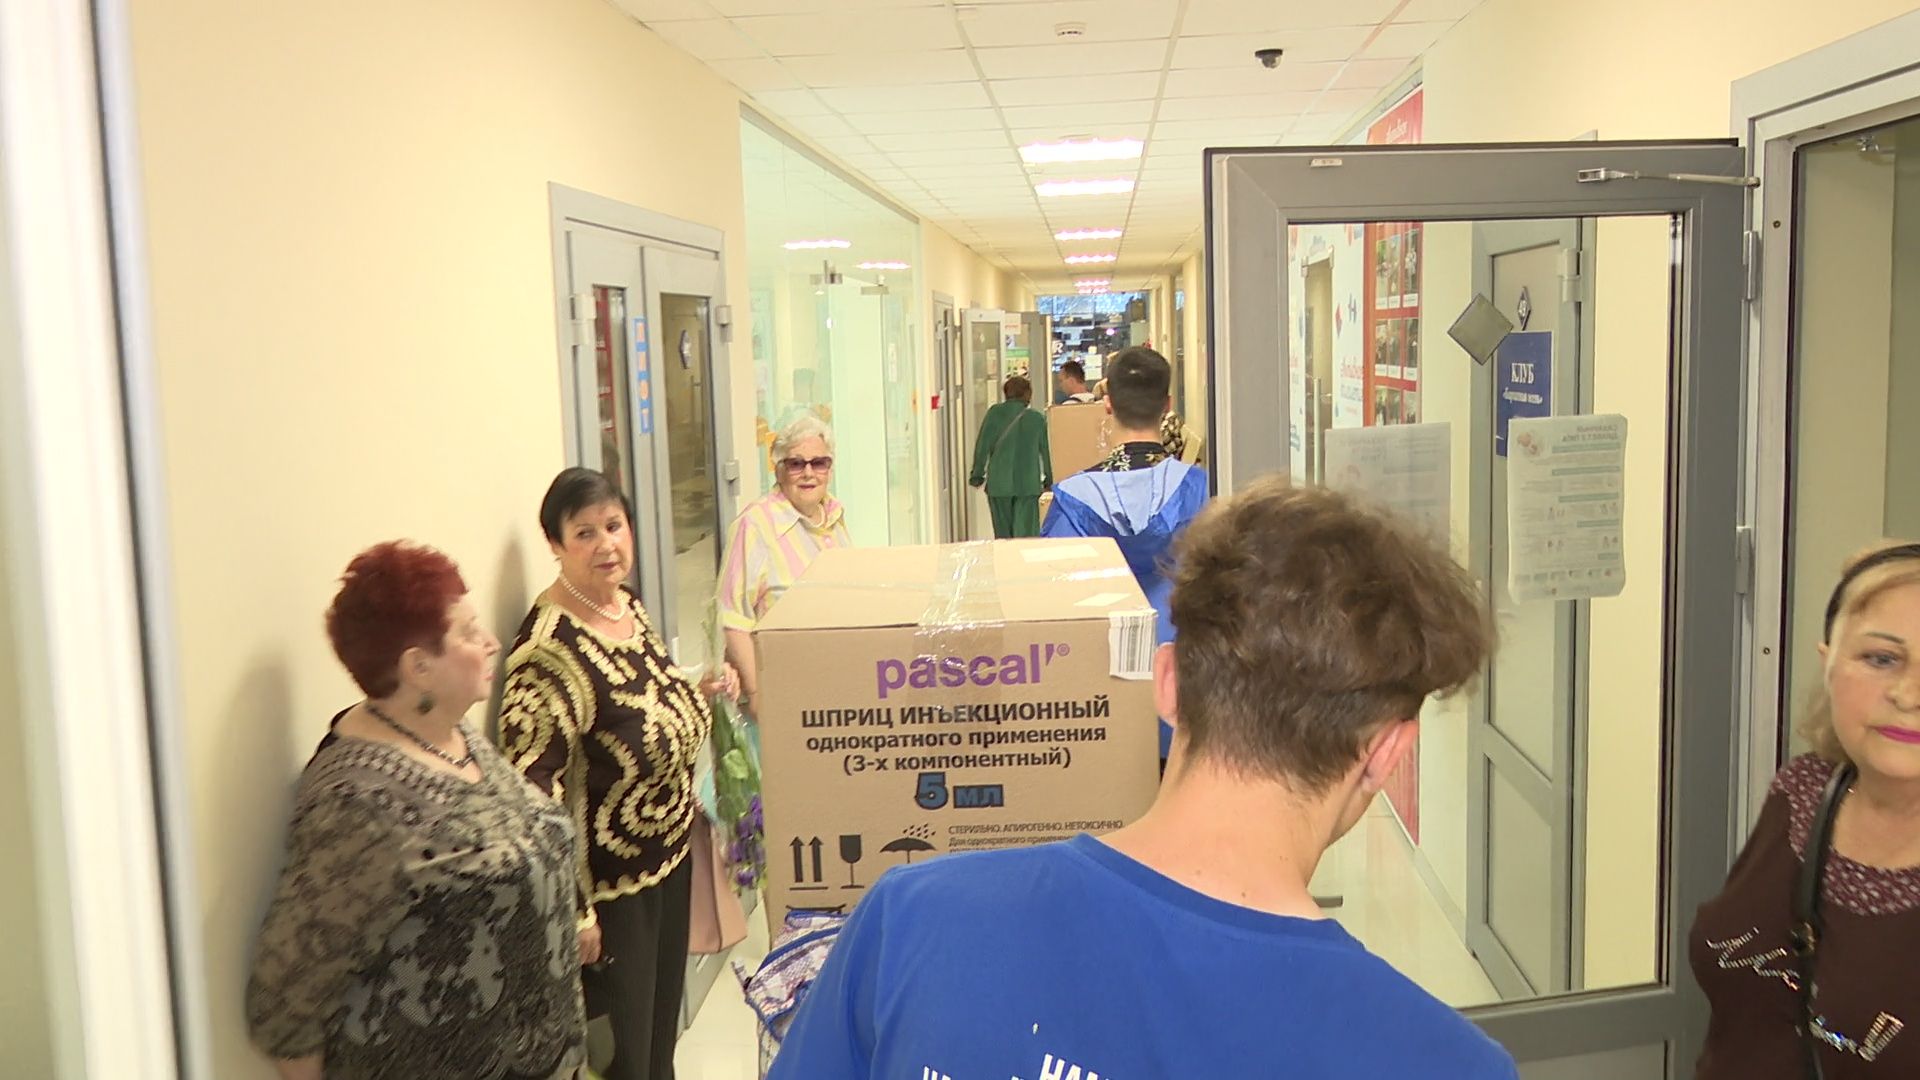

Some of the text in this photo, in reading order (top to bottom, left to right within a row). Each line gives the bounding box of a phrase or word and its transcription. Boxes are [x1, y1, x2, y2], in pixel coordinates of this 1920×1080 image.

[1511, 363, 1535, 384] КЛУБ
[802, 695, 1110, 728] ШПРИЦ ИНЪЕКЦИОННЫЙ
[806, 725, 1107, 752] однократного применения
[843, 747, 1072, 776] (3-х компонентный)
[914, 772, 949, 810] 5
